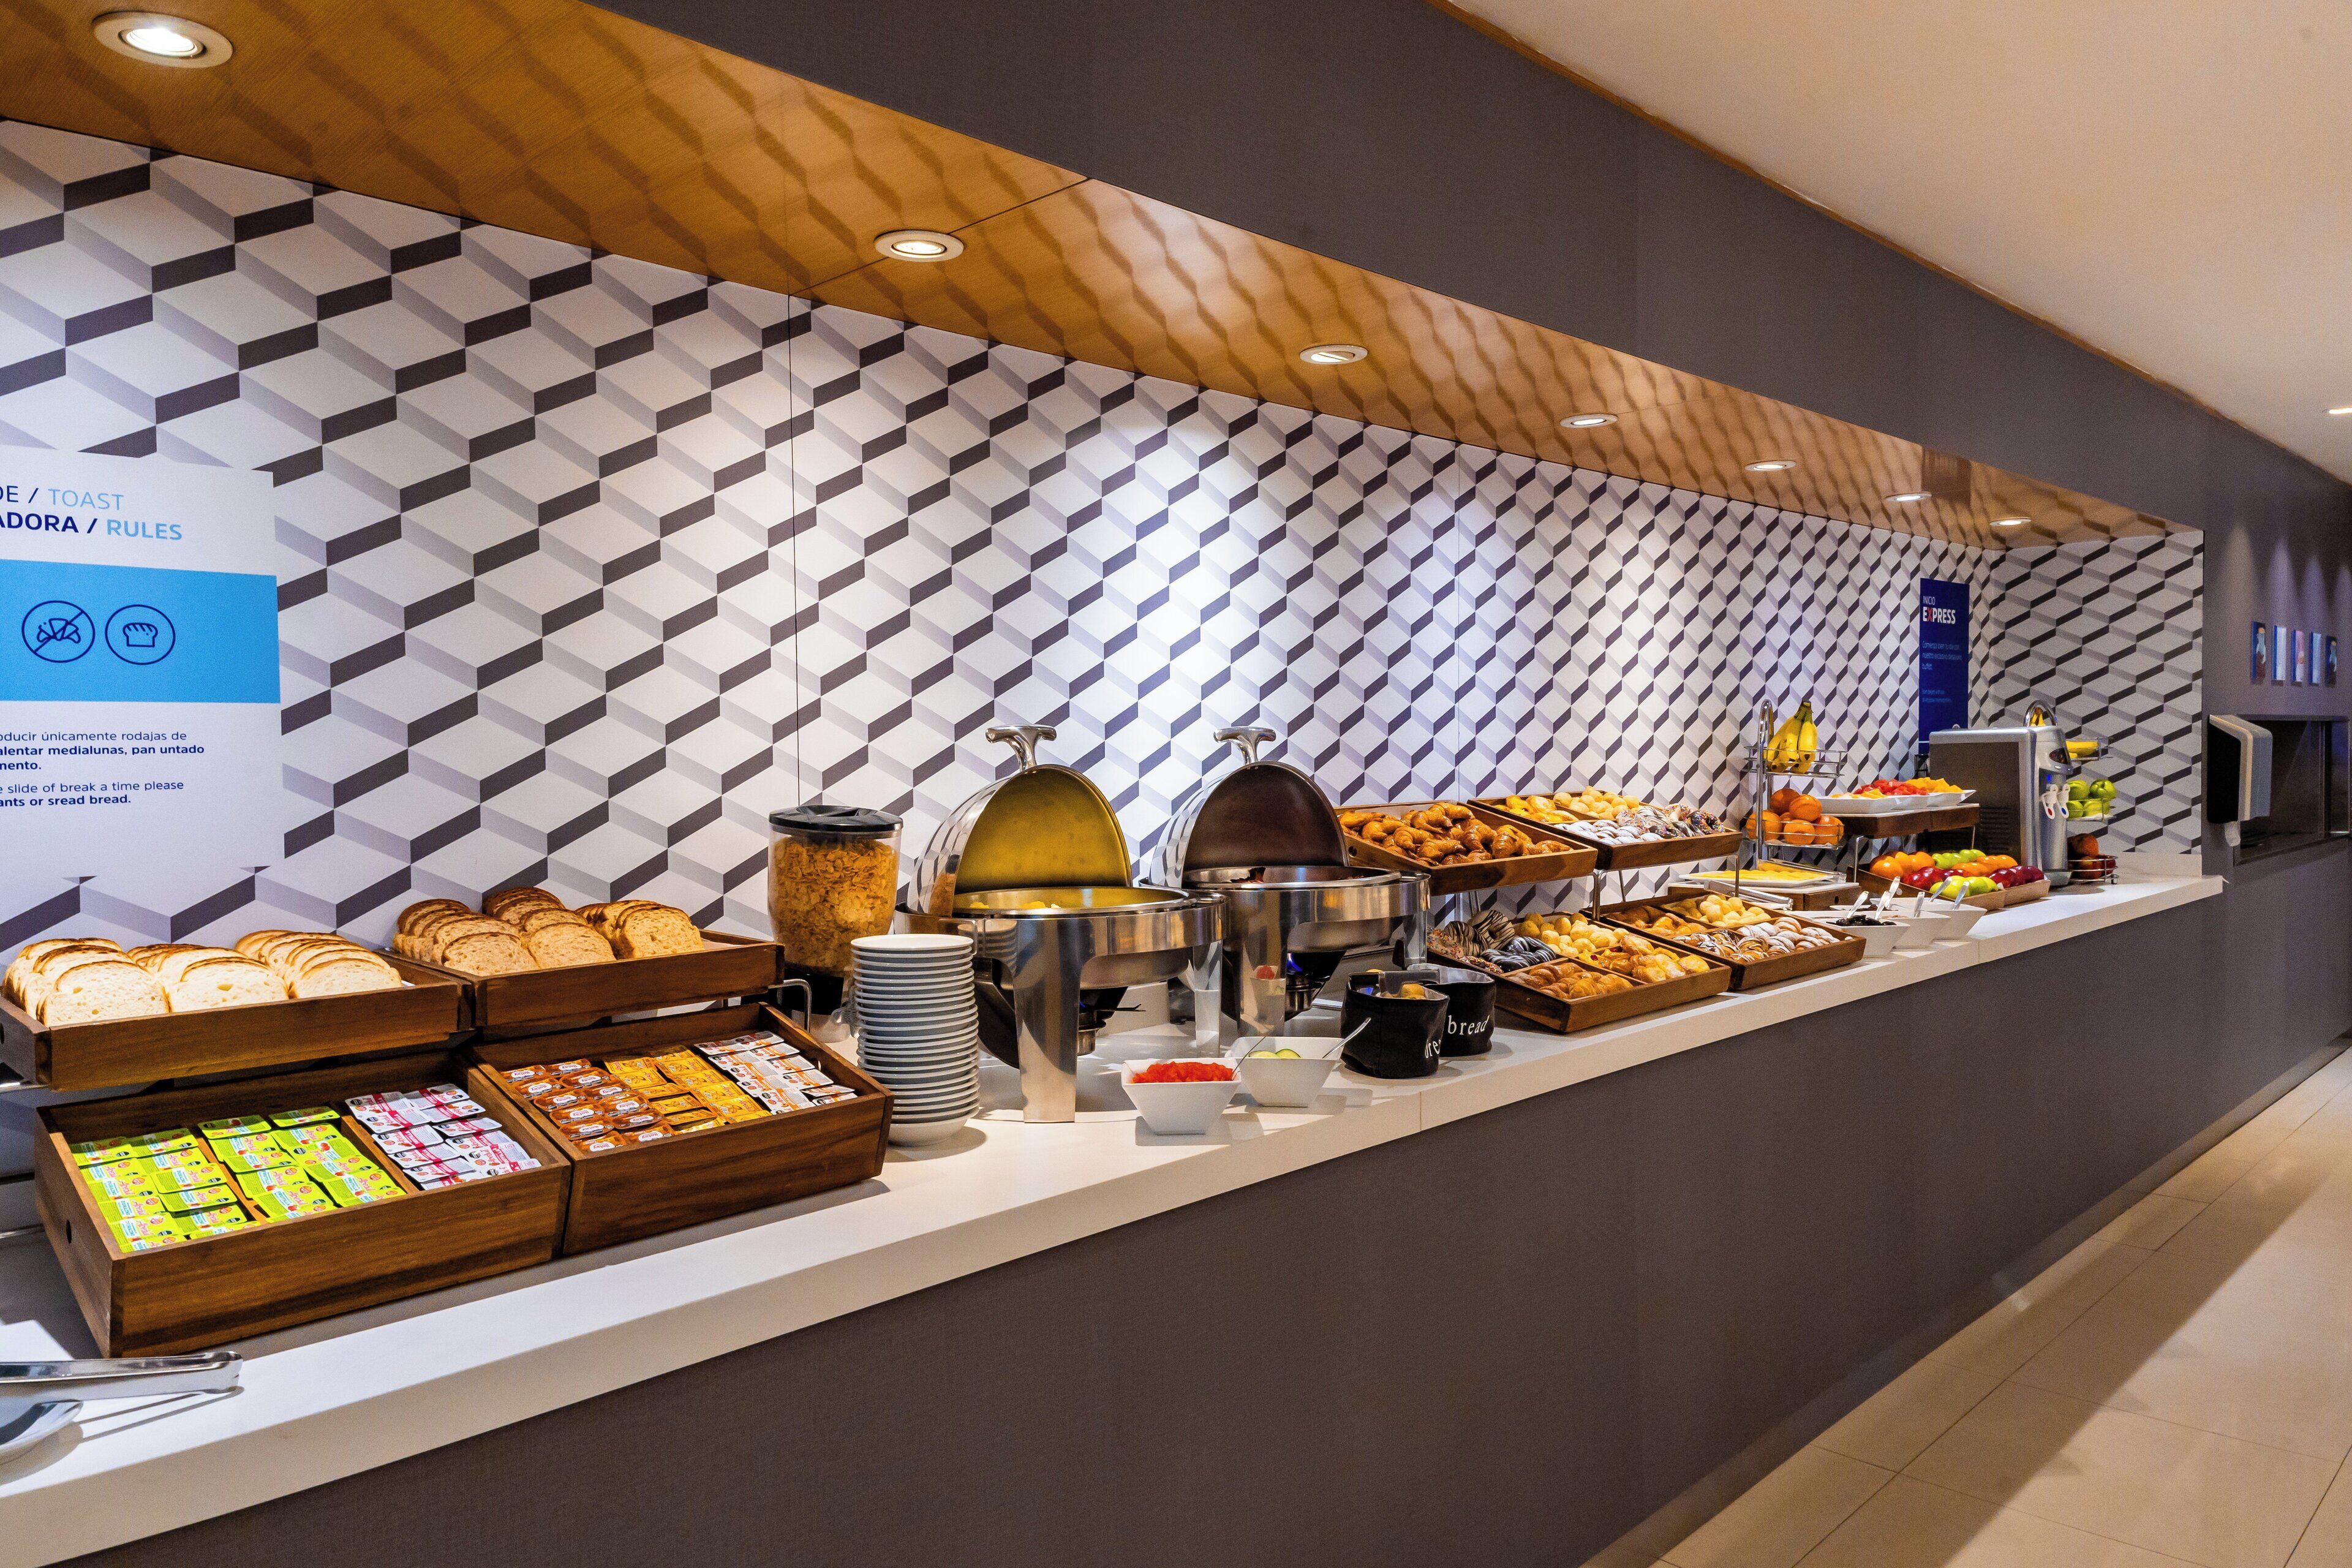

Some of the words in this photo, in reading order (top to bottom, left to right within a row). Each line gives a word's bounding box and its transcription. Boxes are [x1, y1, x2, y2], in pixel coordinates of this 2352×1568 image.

[28, 488, 39, 503] /
[48, 488, 124, 510] TOAST
[86, 518, 98, 534] /
[107, 519, 183, 540] RULES
[1923, 606, 1956, 624] EXPRESS
[42, 731, 116, 741] únicamente
[121, 731, 167, 742] rodajas
[172, 731, 187, 741] de
[48, 745, 127, 756] medialunas,
[132, 747, 156, 755] pan
[160, 745, 205, 754] untado
[8, 784, 37, 794] slide
[43, 783, 55, 793] of
[61, 783, 96, 793] break
[112, 782, 140, 792] time
[145, 781, 184, 791] please
[29, 798, 43, 807] or
[48, 796, 85, 806] sread
[89, 794, 130, 805] bread.
[1447, 1015, 1490, 1036] bread
